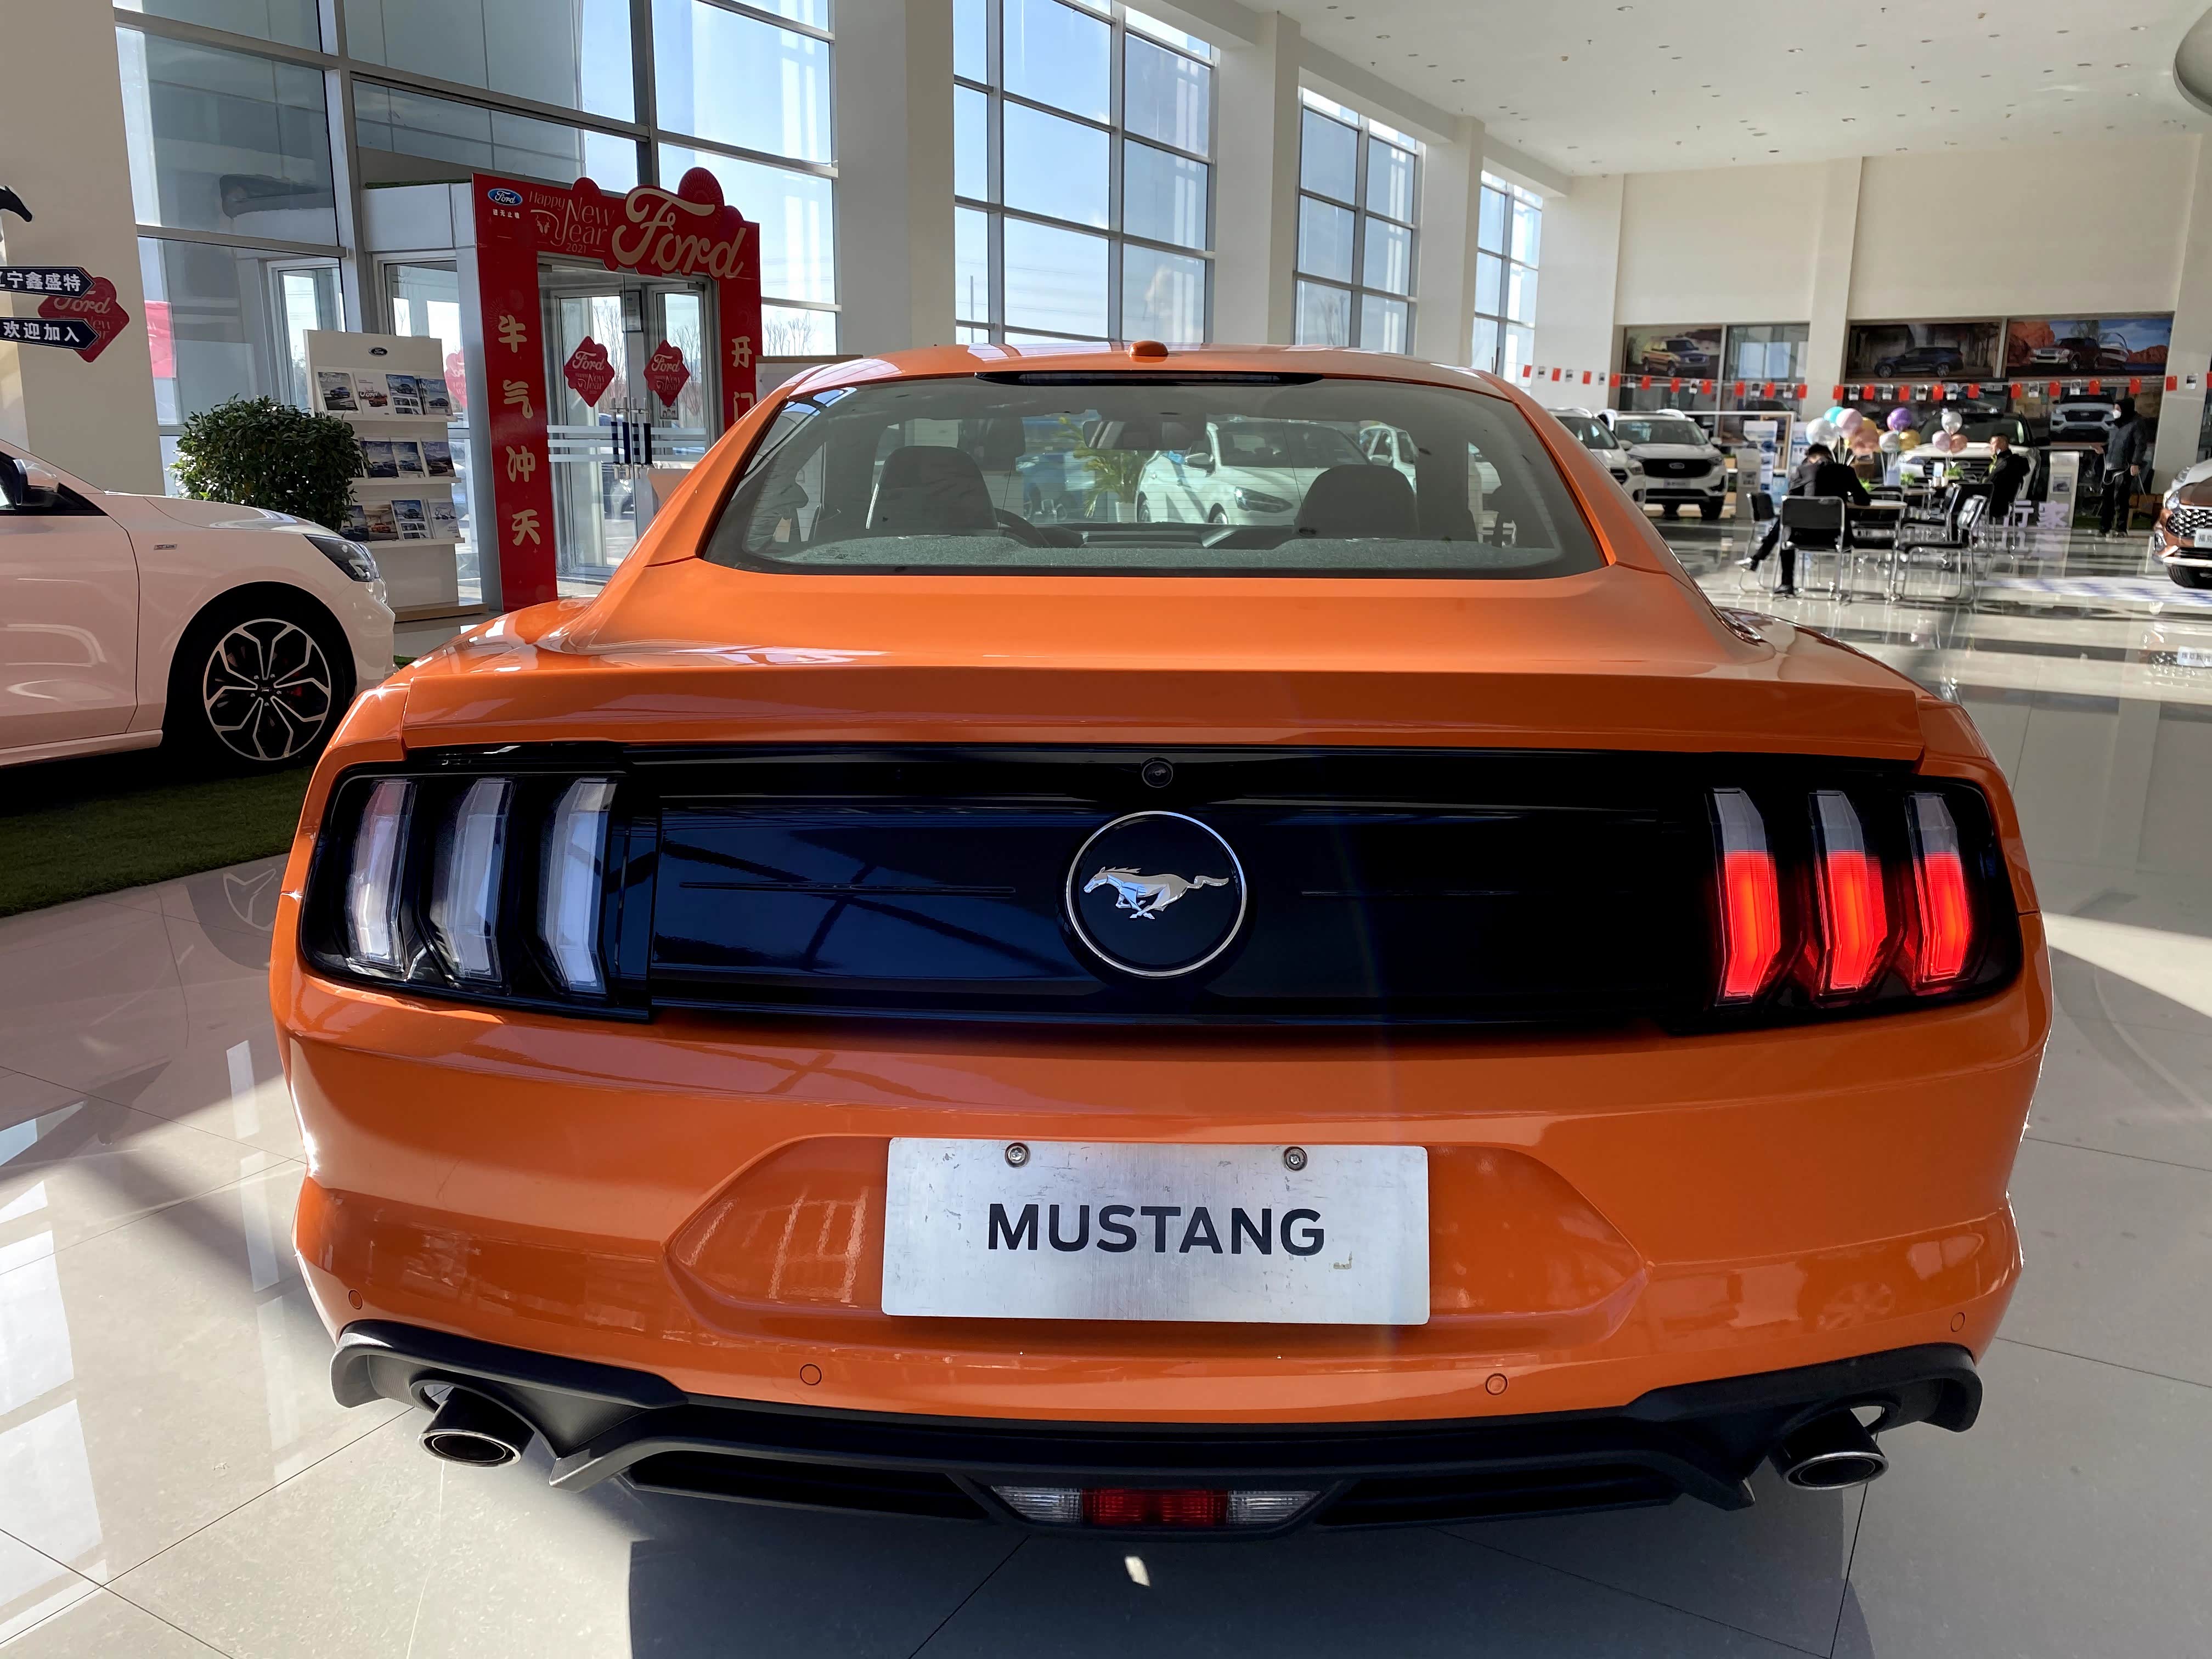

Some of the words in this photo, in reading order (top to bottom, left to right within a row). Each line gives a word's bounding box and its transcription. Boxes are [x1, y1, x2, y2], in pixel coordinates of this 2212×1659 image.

[495, 190, 516, 204] Ford
[529, 191, 566, 211] Happy
[566, 197, 615, 232] New
[550, 221, 607, 246] Year
[612, 188, 746, 279] Ford
[566, 243, 586, 254] 2021
[3, 321, 80, 343] 欢迎加入
[572, 351, 605, 370] Ford
[651, 354, 680, 372] Ford
[498, 315, 540, 546] 牛气冲天
[988, 1203, 1325, 1256] MUSTANG
